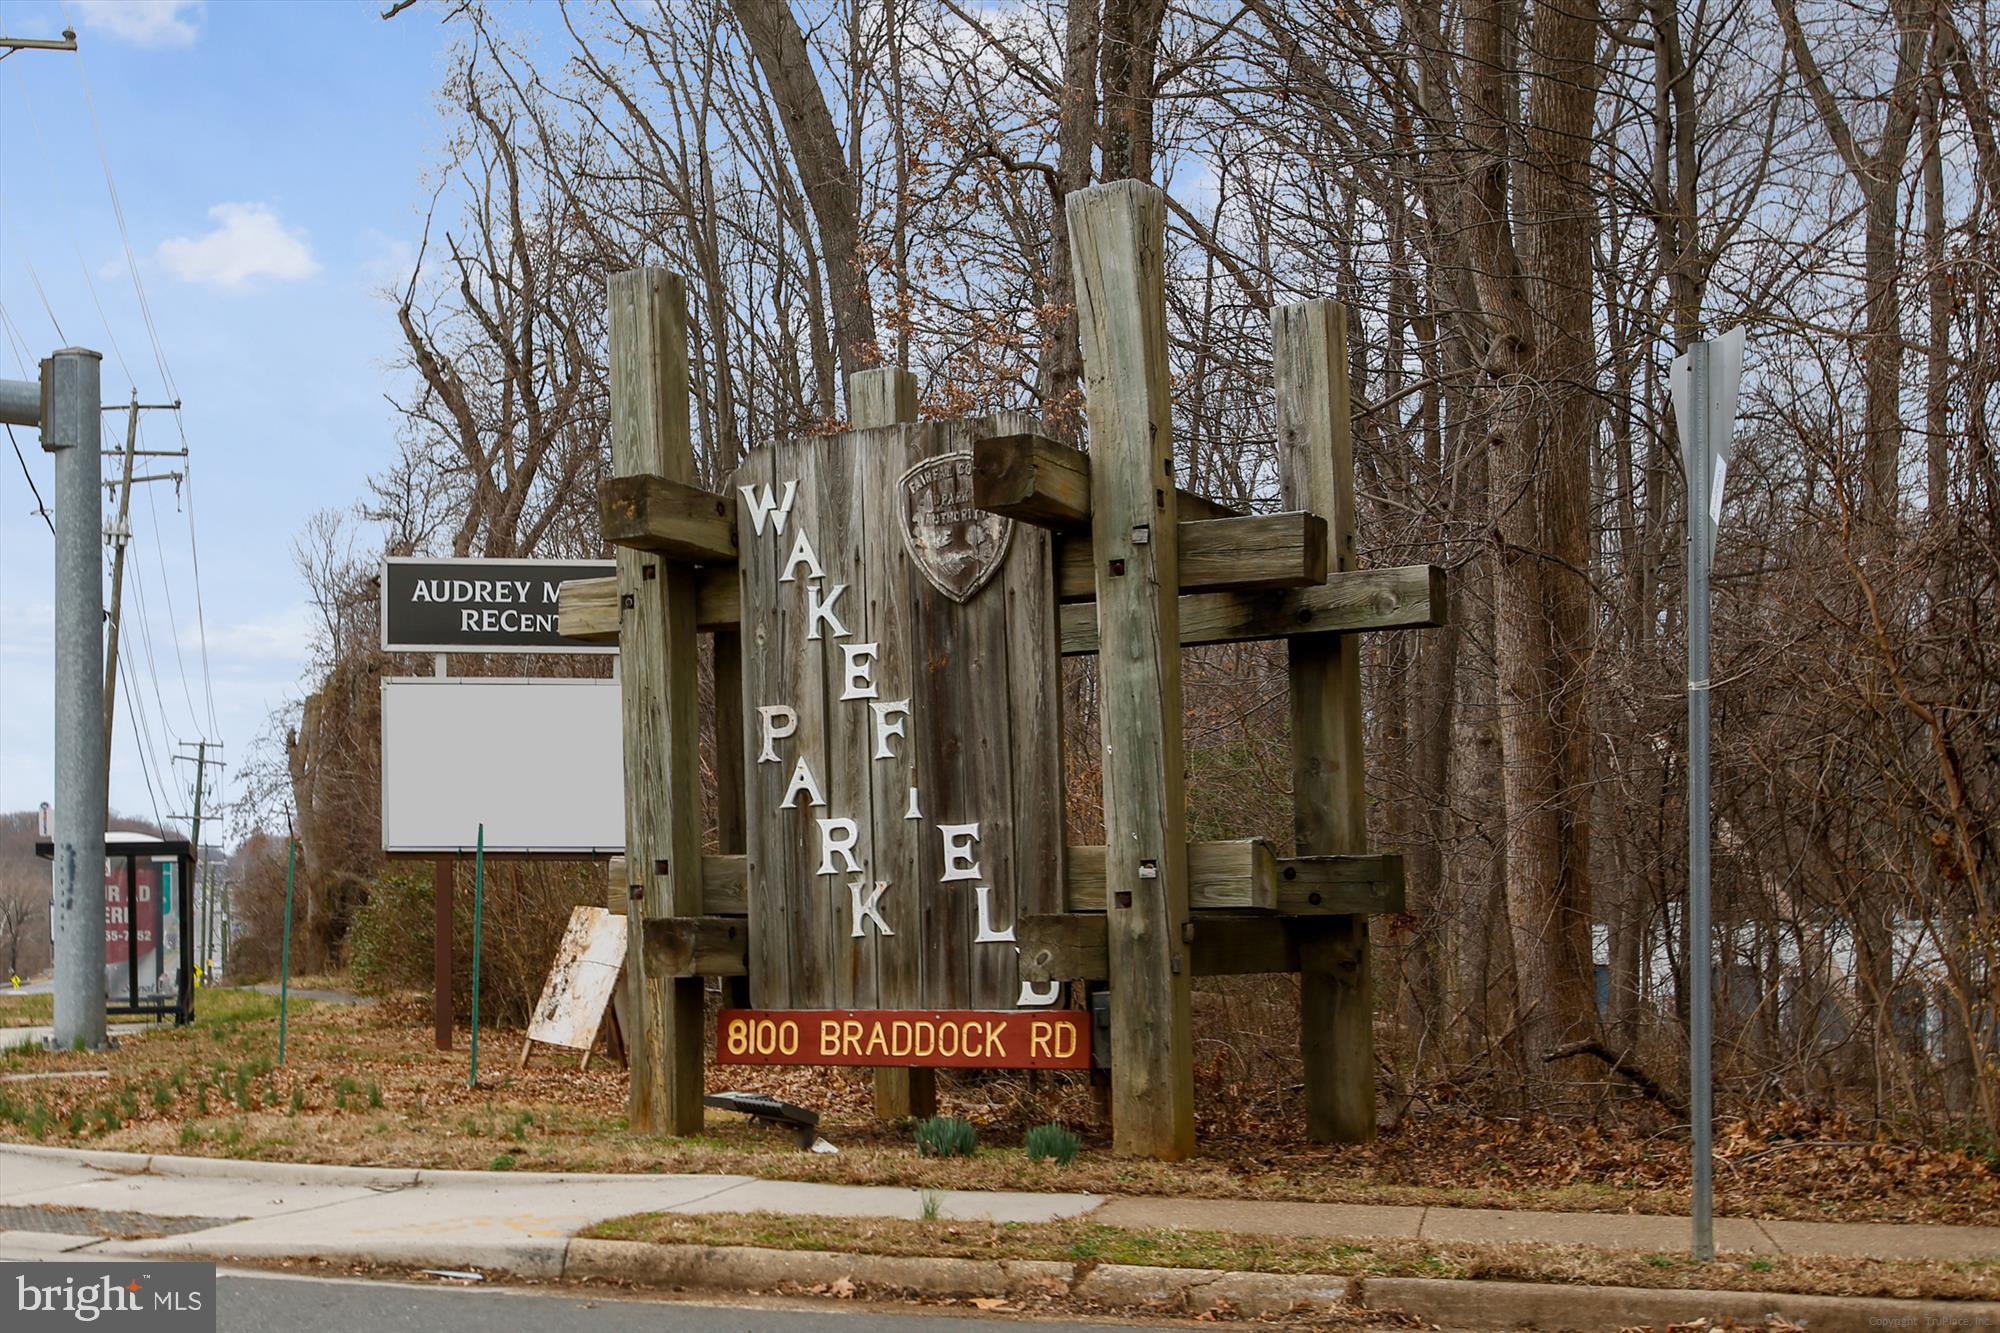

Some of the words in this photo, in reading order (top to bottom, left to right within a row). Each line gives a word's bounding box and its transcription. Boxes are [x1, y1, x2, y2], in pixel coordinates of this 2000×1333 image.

[958, 462, 972, 476] CO
[411, 579, 530, 604] AUDREY
[542, 581, 562, 604] M
[756, 704, 895, 938] PARK
[728, 1019, 799, 1055] 8100
[820, 1020, 1007, 1058] BRADDOCK
[1030, 1021, 1077, 1058] RD
